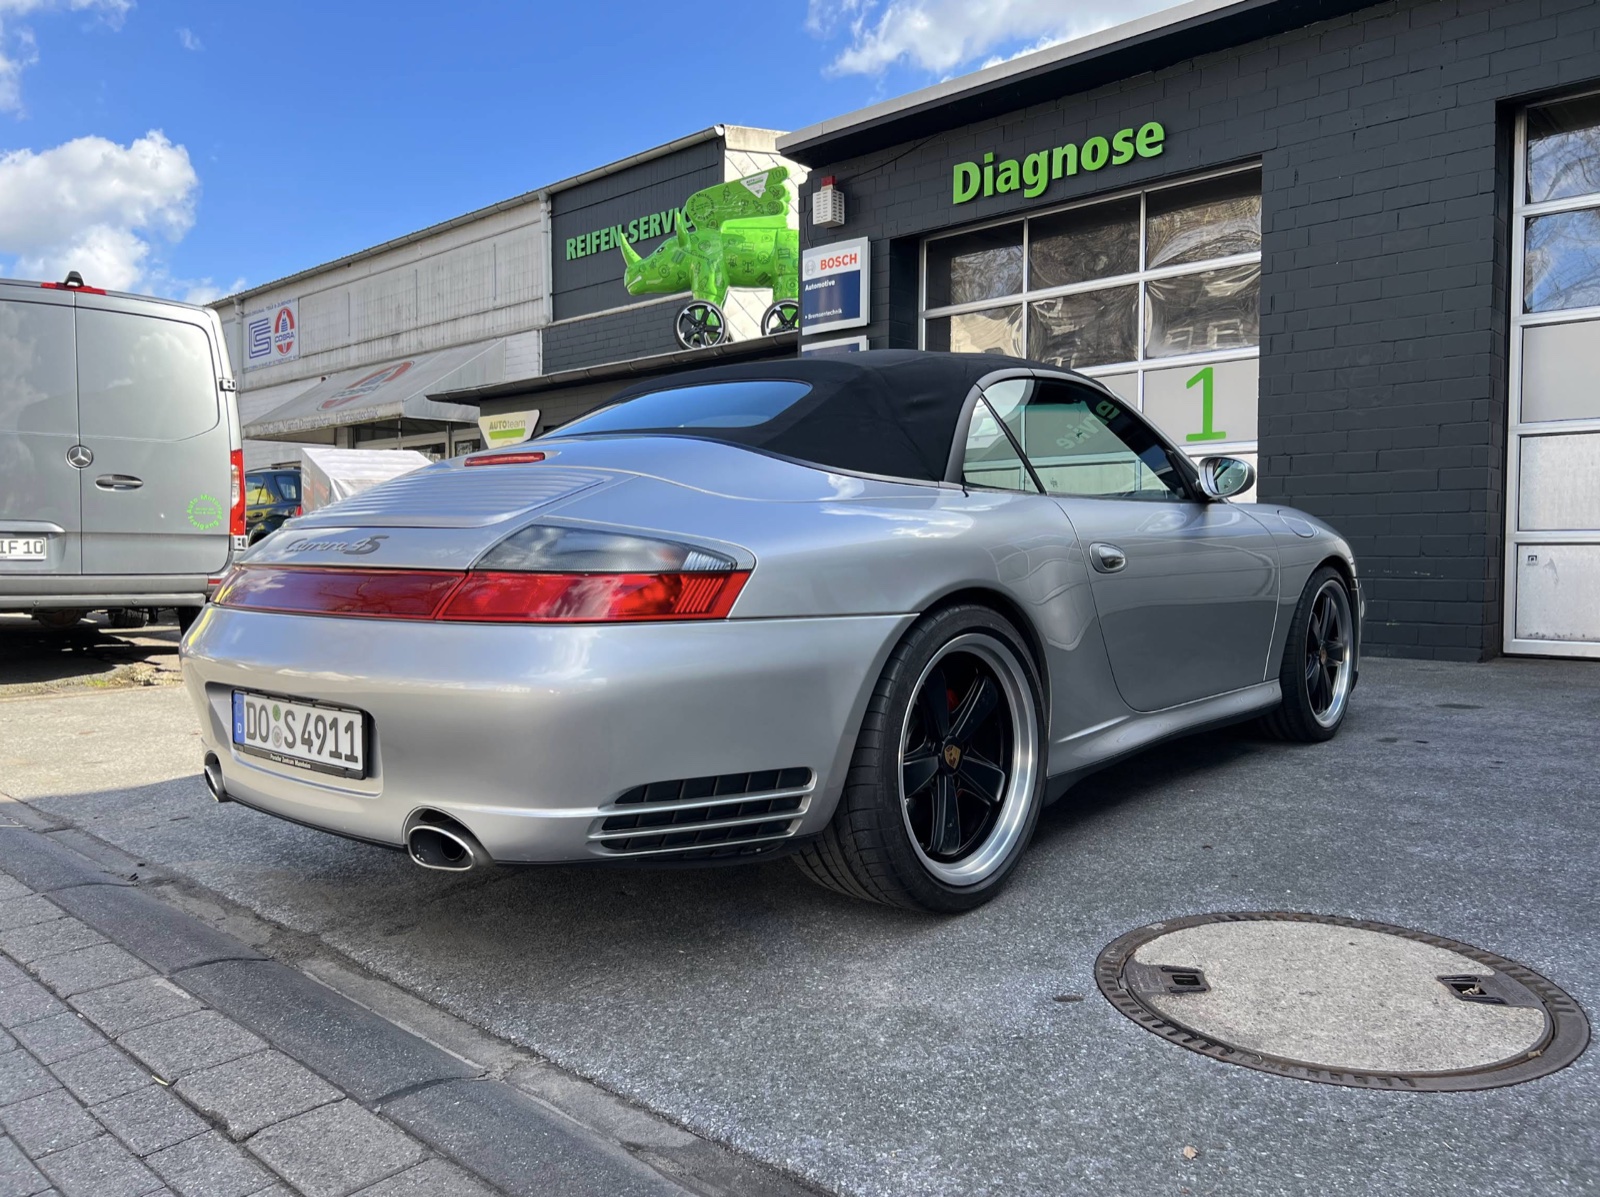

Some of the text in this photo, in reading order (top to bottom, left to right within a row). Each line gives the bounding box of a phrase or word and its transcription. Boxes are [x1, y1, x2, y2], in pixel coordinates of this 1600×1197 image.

[953, 121, 1165, 205] Diagnose
[566, 207, 693, 261] REIFEN-SERVIC
[820, 253, 858, 271] BOSCH
[805, 279, 836, 292] Automotive
[275, 331, 295, 343] COBRA
[1186, 366, 1226, 441] 1
[489, 420, 526, 431] AUTOteam
[23, 540, 44, 554] 10
[285, 537, 349, 553] Carrera
[237, 722, 243, 733] D
[245, 701, 270, 743] DO
